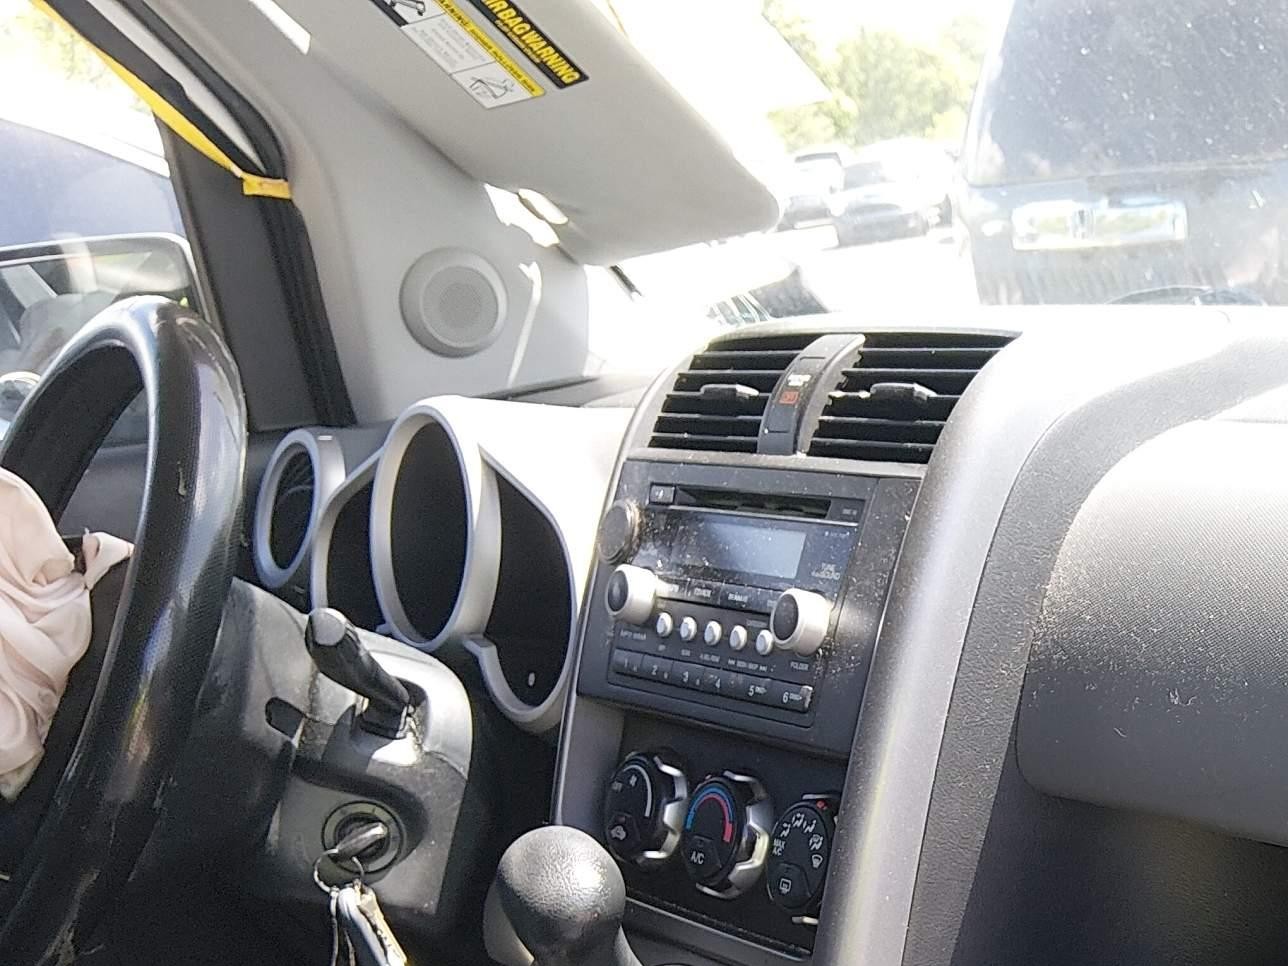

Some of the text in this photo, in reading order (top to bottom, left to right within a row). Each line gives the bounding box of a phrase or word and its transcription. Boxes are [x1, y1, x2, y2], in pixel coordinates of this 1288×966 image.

[521, 30, 581, 85] WARNING
[651, 664, 659, 676] 2
[681, 671, 689, 683] 3
[748, 685, 755, 697] 5
[782, 692, 789, 704] 6
[691, 851, 705, 865] A/C
